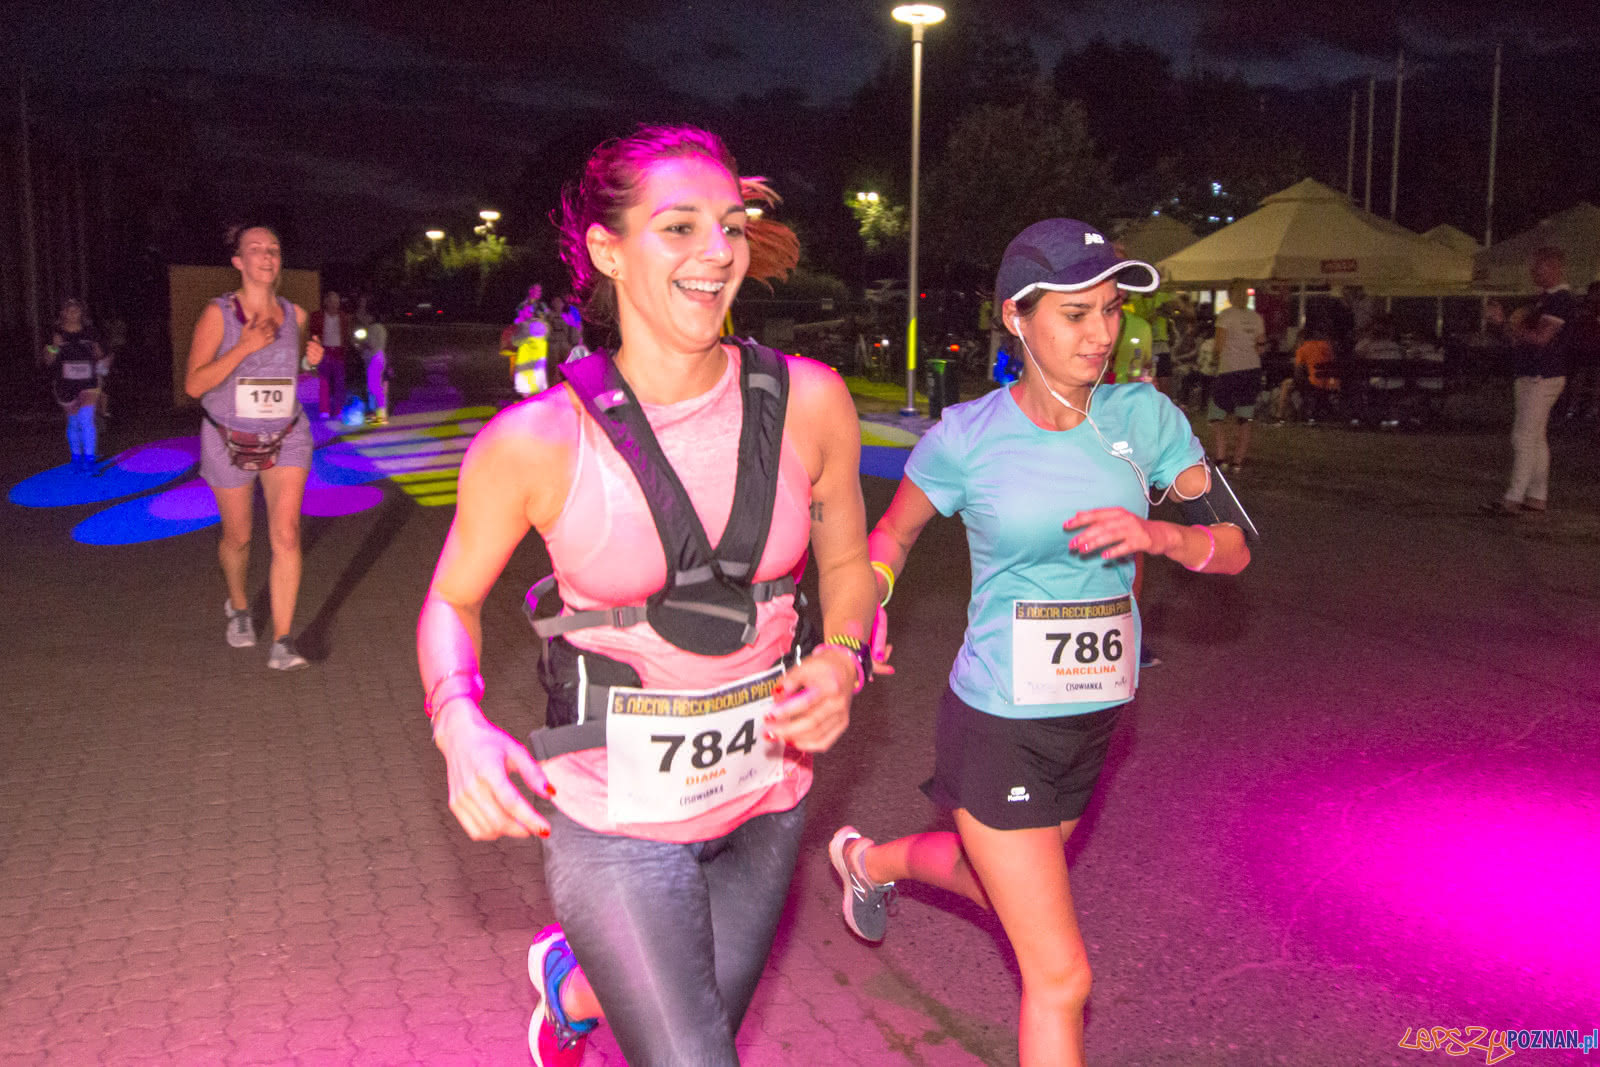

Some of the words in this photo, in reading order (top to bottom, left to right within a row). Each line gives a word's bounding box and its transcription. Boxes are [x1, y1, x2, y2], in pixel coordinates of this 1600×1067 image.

[250, 390, 283, 403] 170
[1045, 628, 1123, 665] 786
[1055, 664, 1117, 676] MARCELINA
[1065, 681, 1103, 692] CISOWIANKA
[650, 718, 757, 773] 784
[685, 767, 727, 786] DIANA
